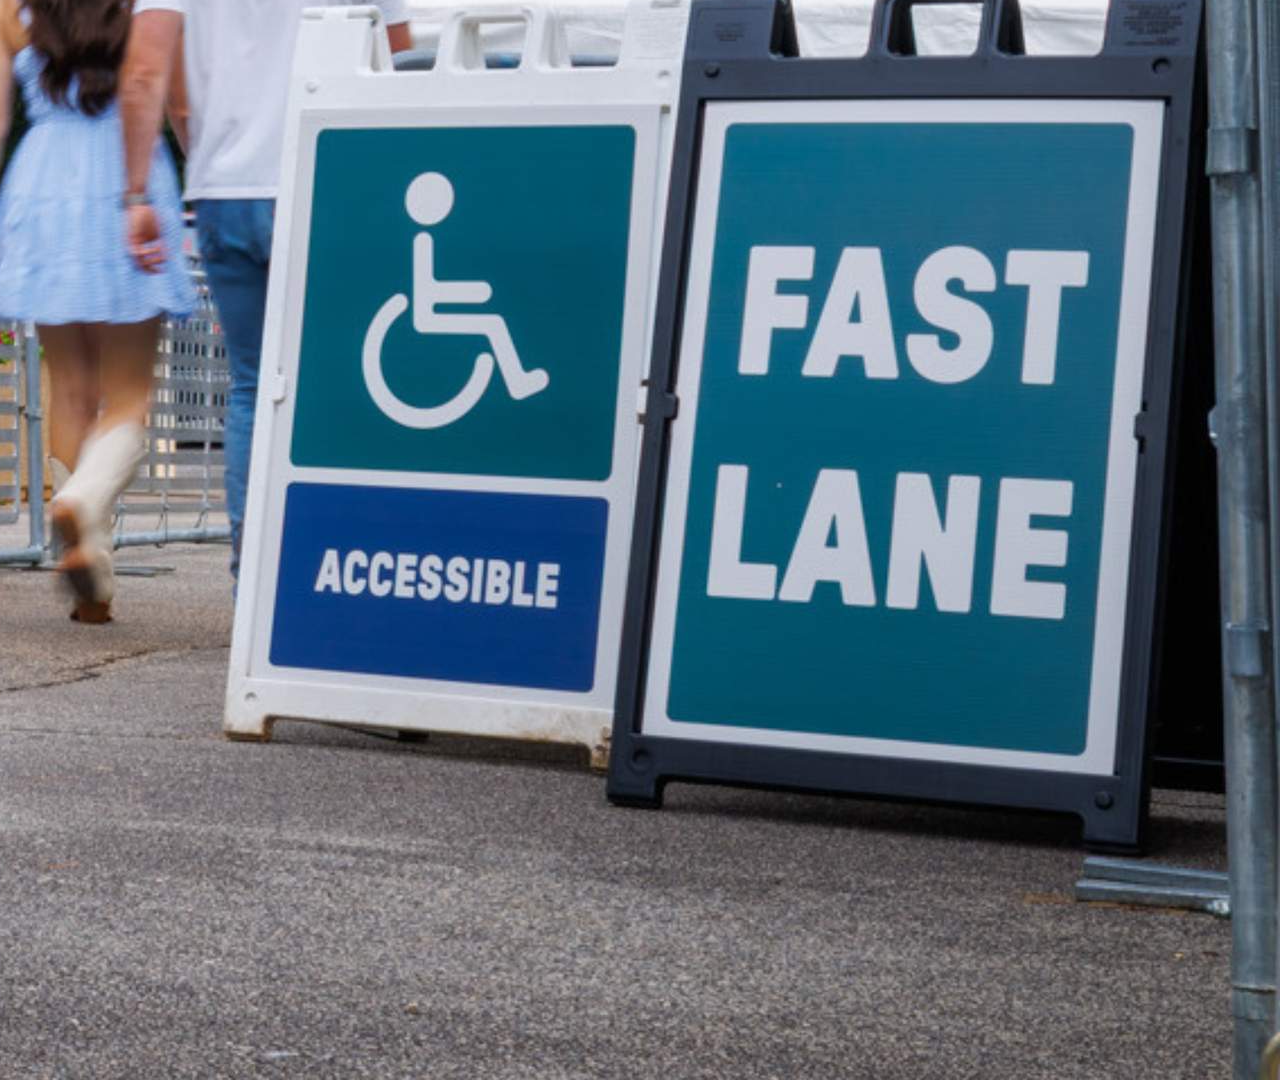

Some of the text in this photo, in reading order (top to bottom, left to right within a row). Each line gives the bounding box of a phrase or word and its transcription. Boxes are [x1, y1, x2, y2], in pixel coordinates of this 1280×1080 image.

[738, 245, 1090, 385] FAST
[314, 549, 560, 608] ACCESSIBLE
[706, 464, 1074, 620] LANE
